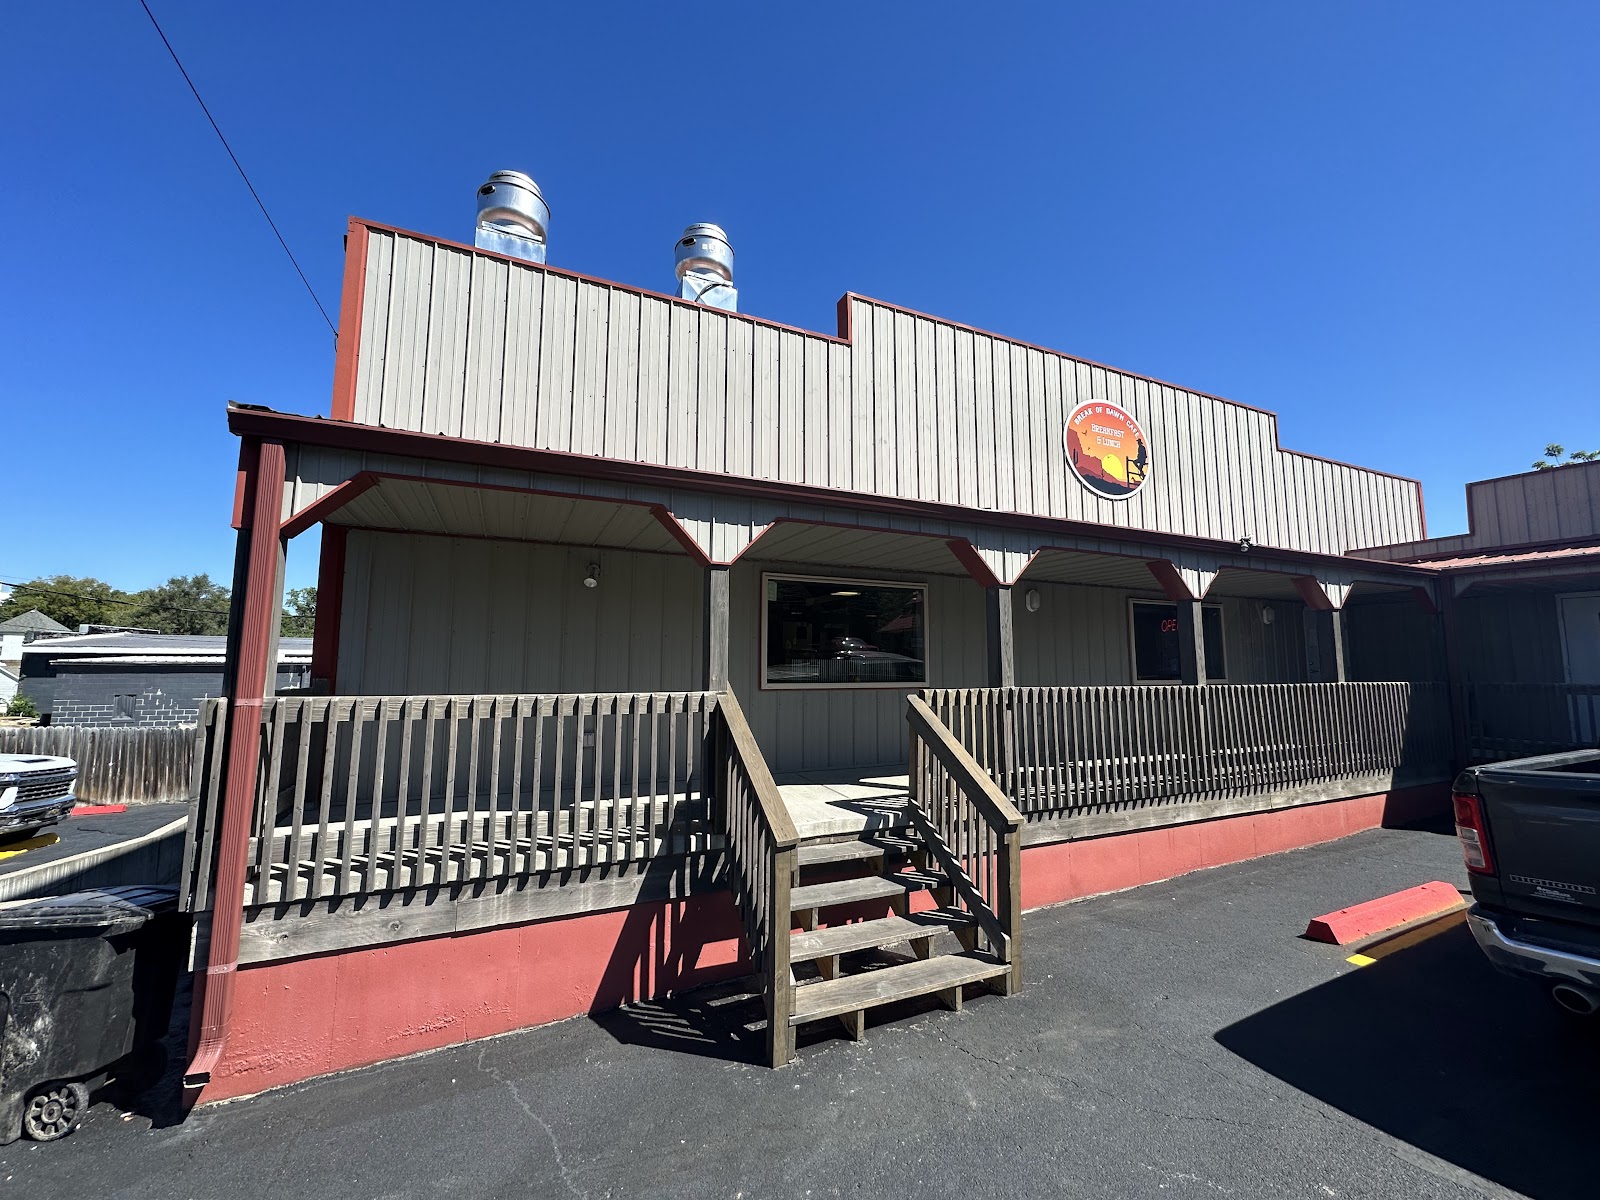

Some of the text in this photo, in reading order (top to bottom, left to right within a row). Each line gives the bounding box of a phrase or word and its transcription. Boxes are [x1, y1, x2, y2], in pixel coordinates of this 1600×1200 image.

[1074, 406, 1140, 438] BREAK OF DAWN CAFE
[1091, 423, 1125, 438] BREAKFAST
[1096, 435, 1121, 448] & LUNCH
